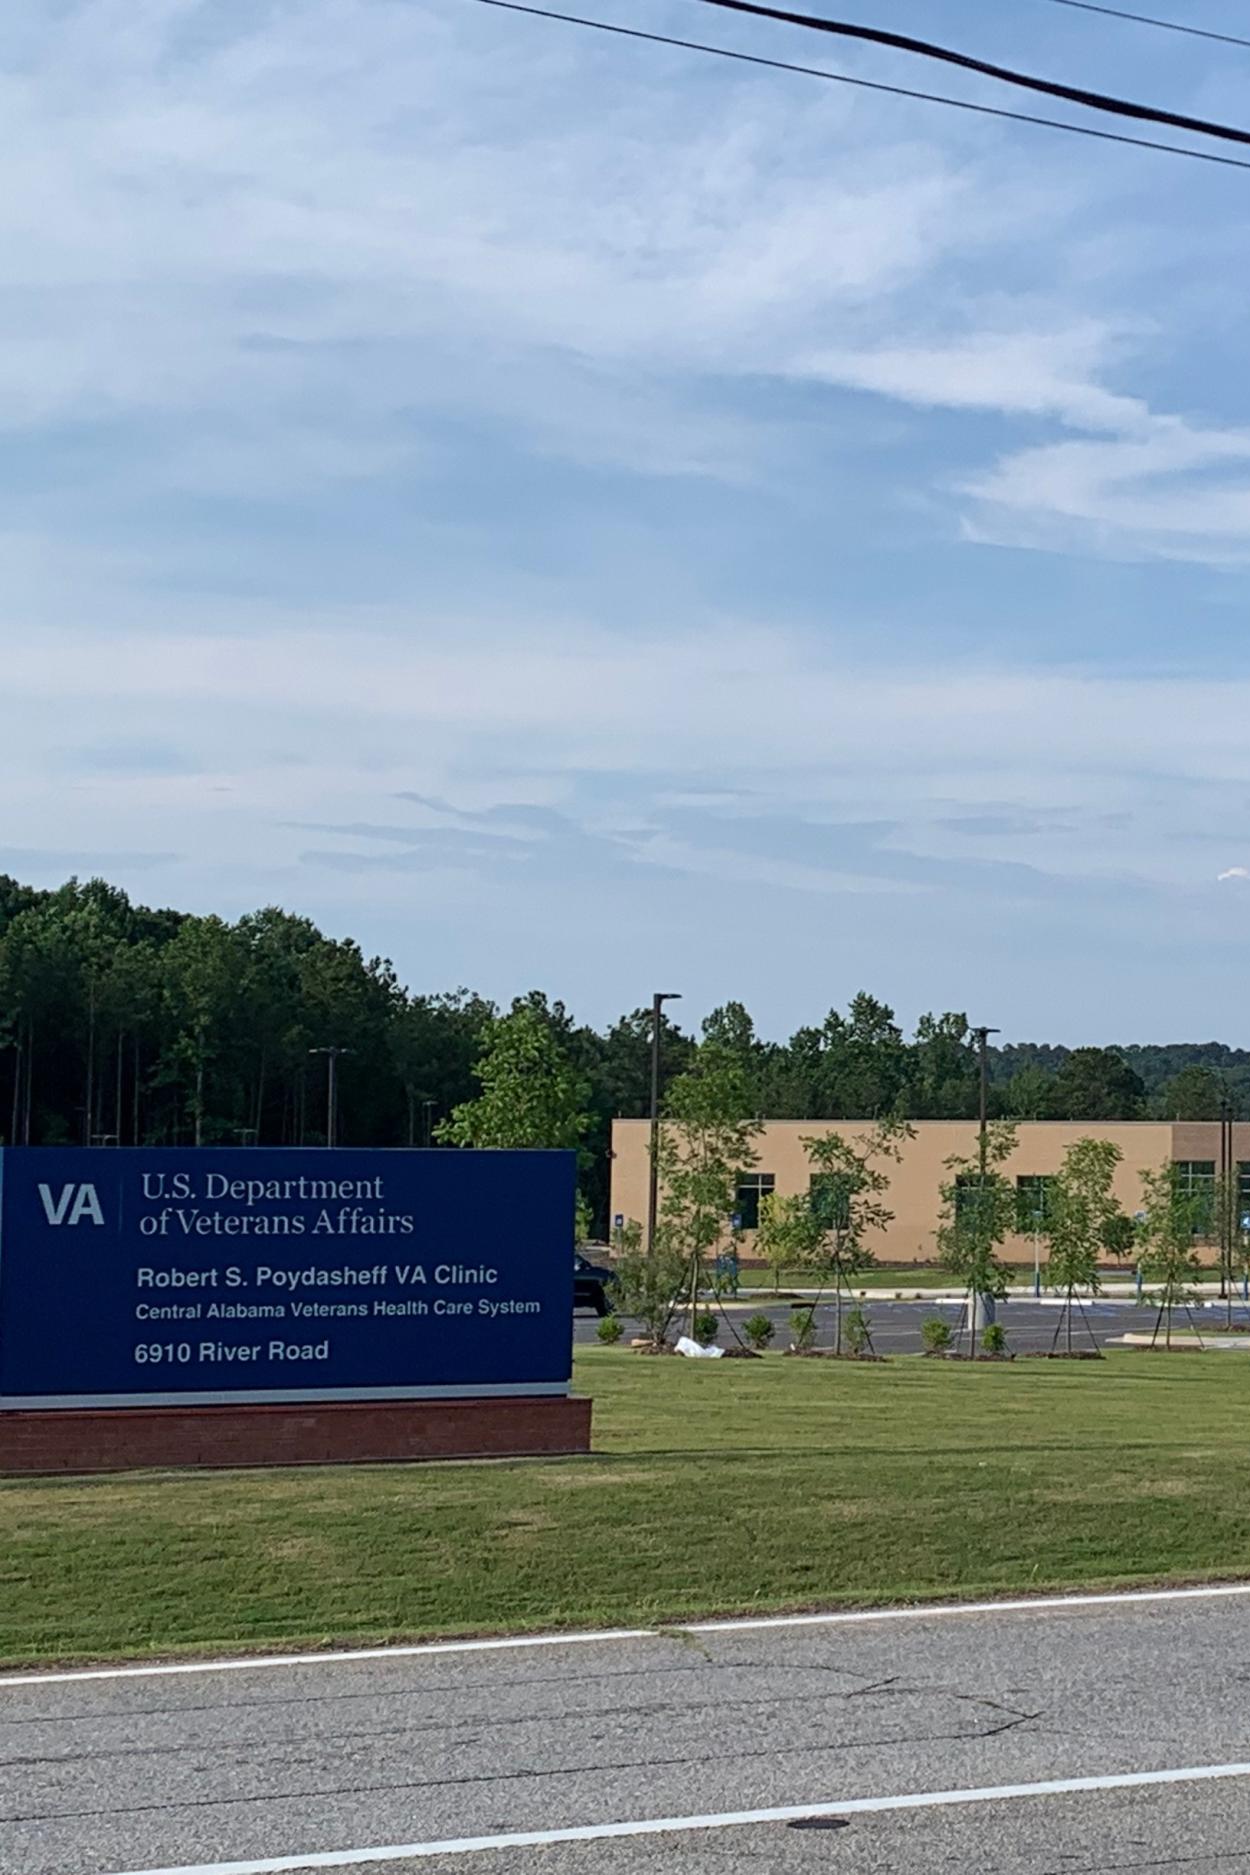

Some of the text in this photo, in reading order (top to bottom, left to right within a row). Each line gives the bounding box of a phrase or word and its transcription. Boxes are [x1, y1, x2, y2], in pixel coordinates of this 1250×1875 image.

[142, 1173, 384, 1206] U.S. Department
[37, 1183, 105, 1225] VA
[139, 1206, 414, 1235] of Veterans Affairs
[137, 1264, 498, 1291] Robert S. Poydasheff VA Clinic
[135, 1298, 541, 1320] Central Alabama Veterans Health Care System
[134, 1340, 329, 1364] 6910 River Road
